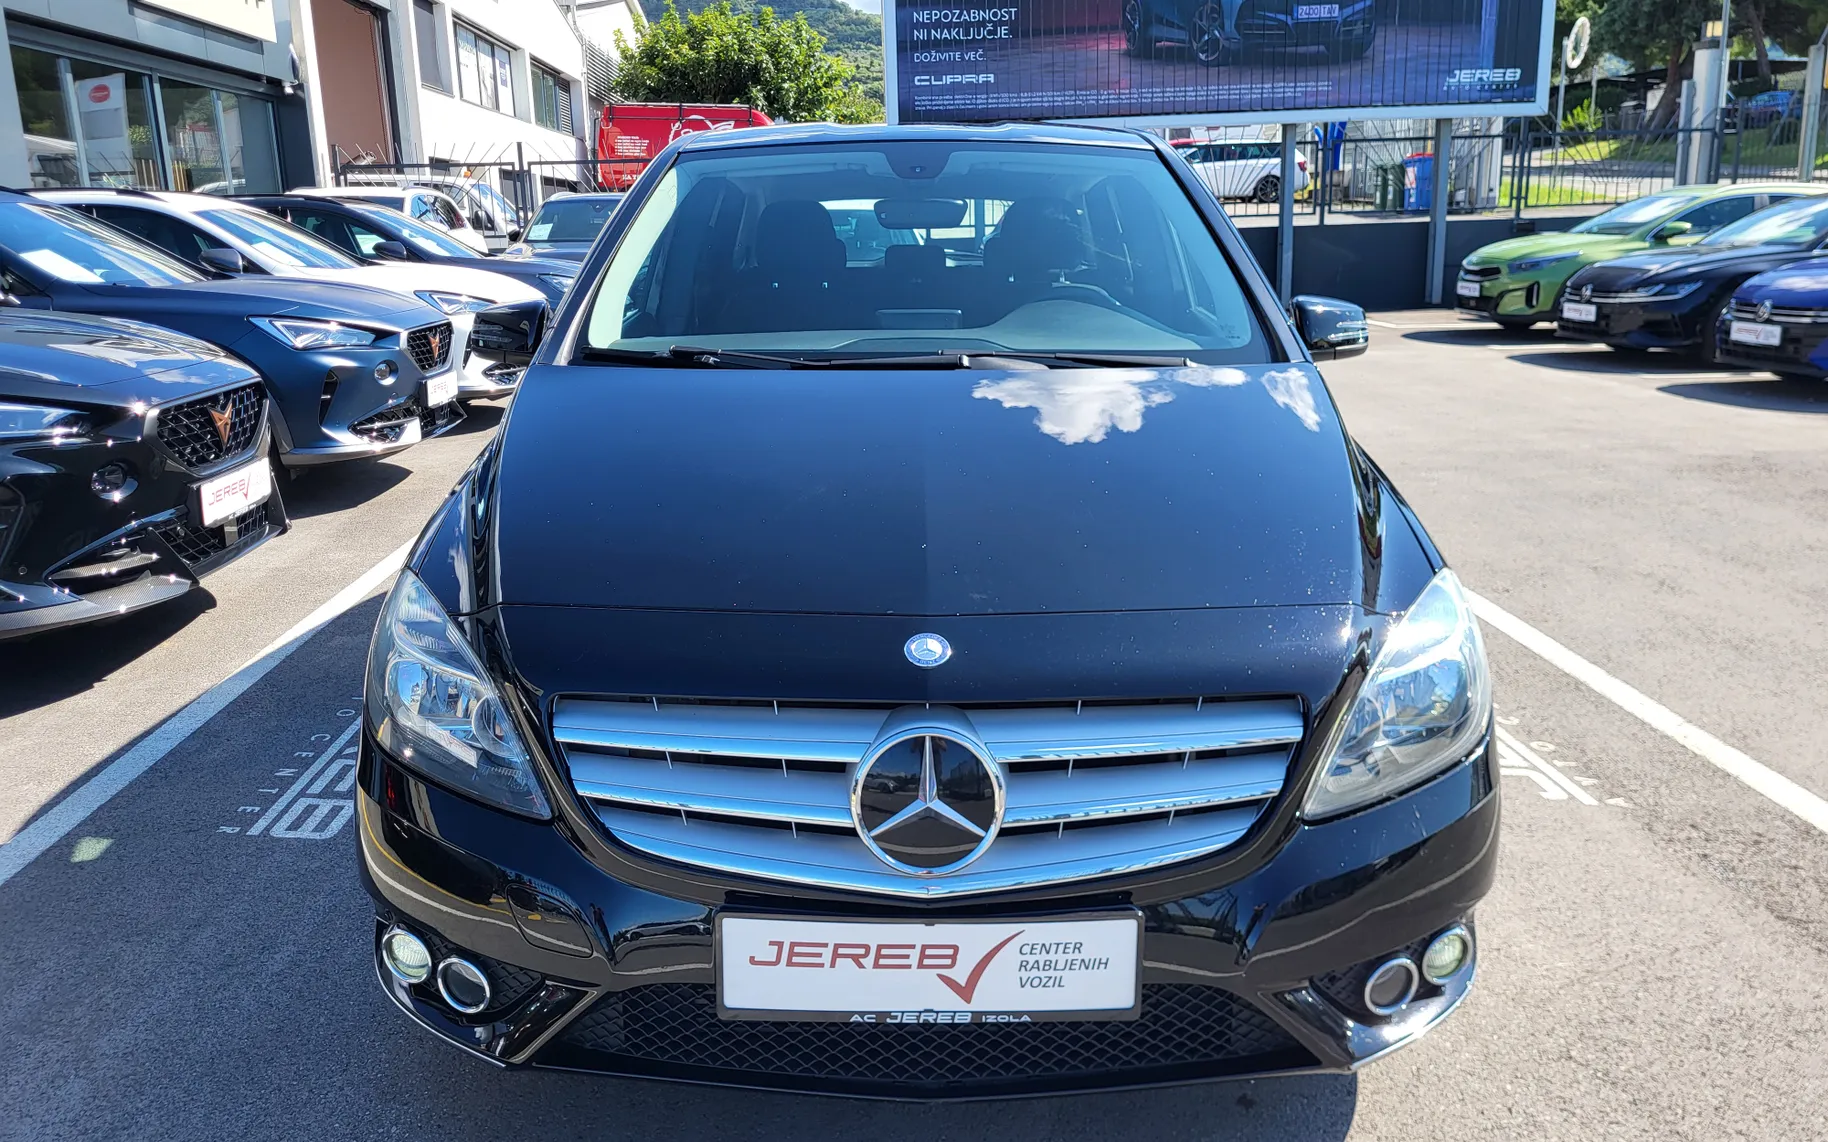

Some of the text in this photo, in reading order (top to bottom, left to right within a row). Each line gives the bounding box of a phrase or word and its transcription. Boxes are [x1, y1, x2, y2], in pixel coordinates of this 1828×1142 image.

[913, 8, 1018, 23] NEPOZABNOST
[913, 23, 1013, 41] NI NAKLJUČJE.
[914, 48, 987, 63] DOŽIVITE VEČ.
[914, 73, 995, 86] CUPRA
[1447, 68, 1522, 82] JEREB
[208, 478, 246, 506] JEREB
[749, 940, 960, 970] JEREB
[1019, 942, 1083, 955] CENTER
[1018, 957, 1110, 972] RABLJENIH
[1019, 975, 1065, 988] VOZIL
[850, 1012, 1032, 1024] AC JEREB IZOLA
